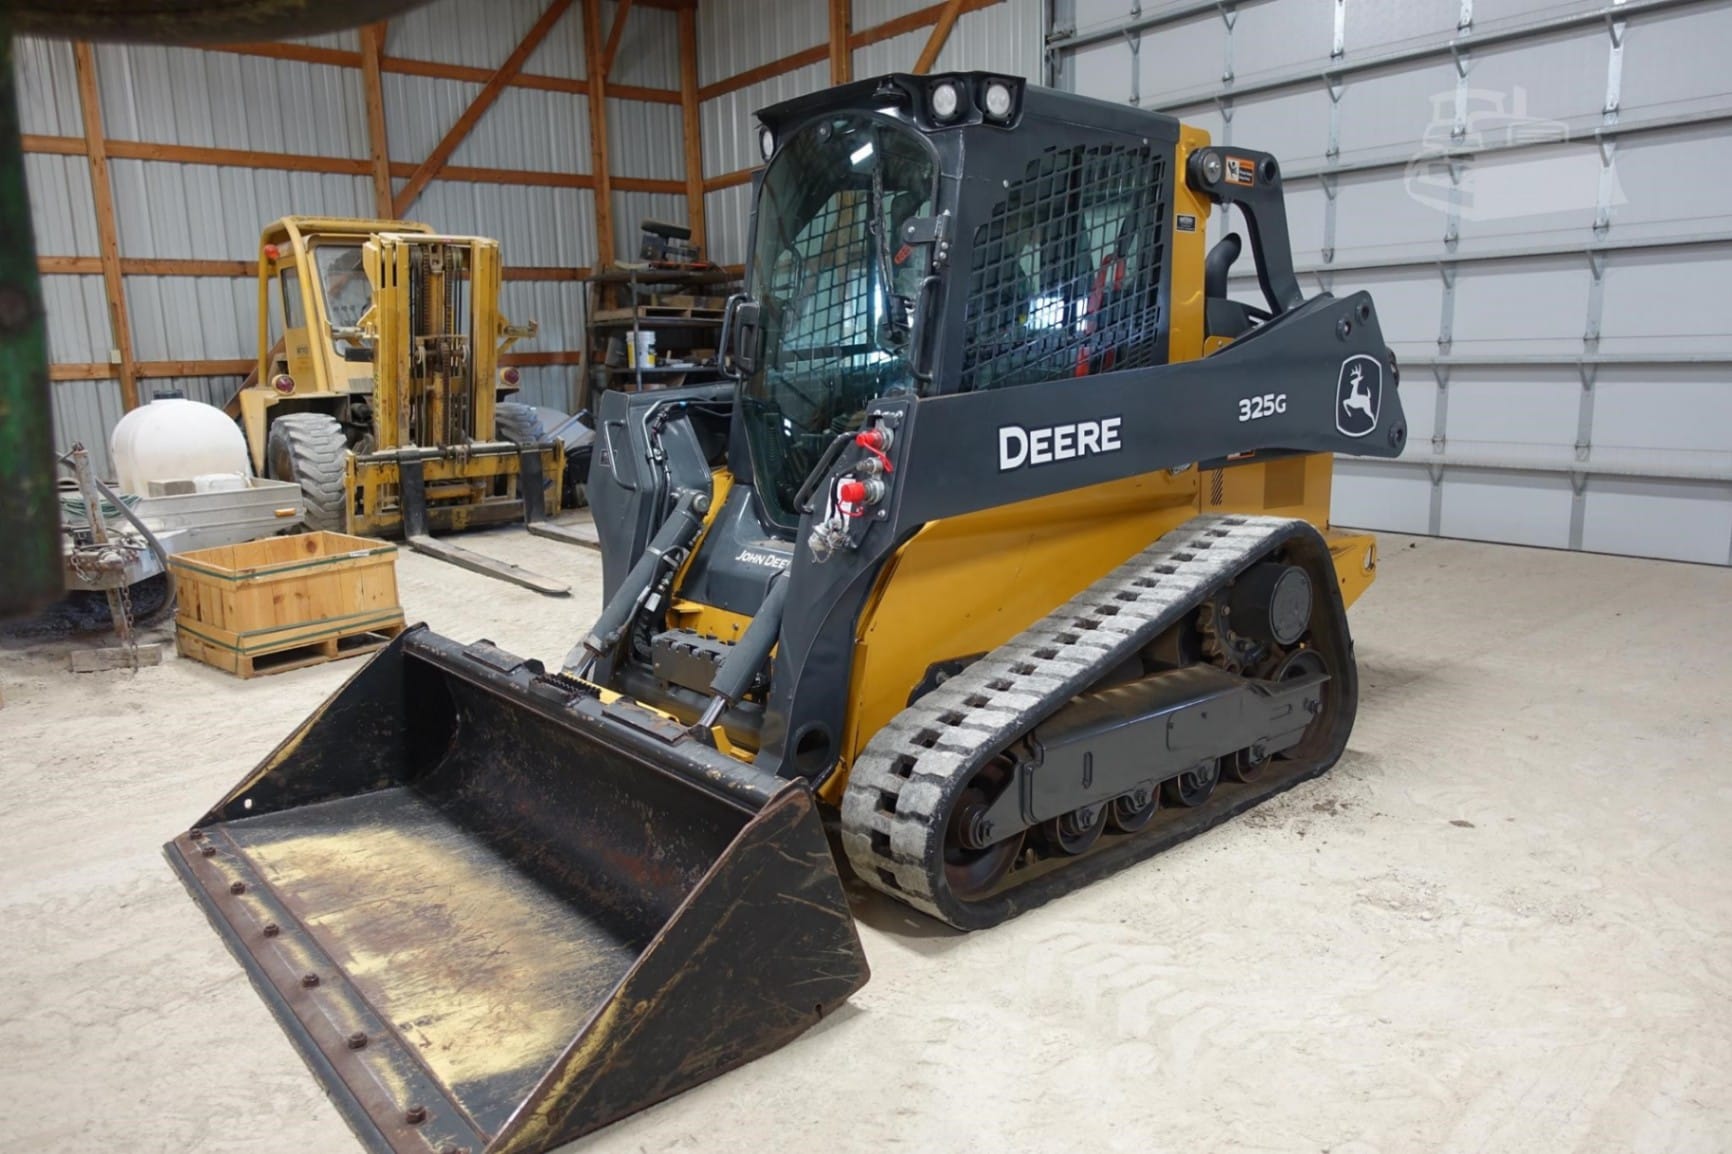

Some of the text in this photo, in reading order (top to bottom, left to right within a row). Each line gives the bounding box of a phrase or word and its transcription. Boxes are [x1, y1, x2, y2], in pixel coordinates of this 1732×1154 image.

[1239, 393, 1286, 421] 325G
[999, 416, 1122, 471] DEERE
[735, 549, 766, 566] JOHN
